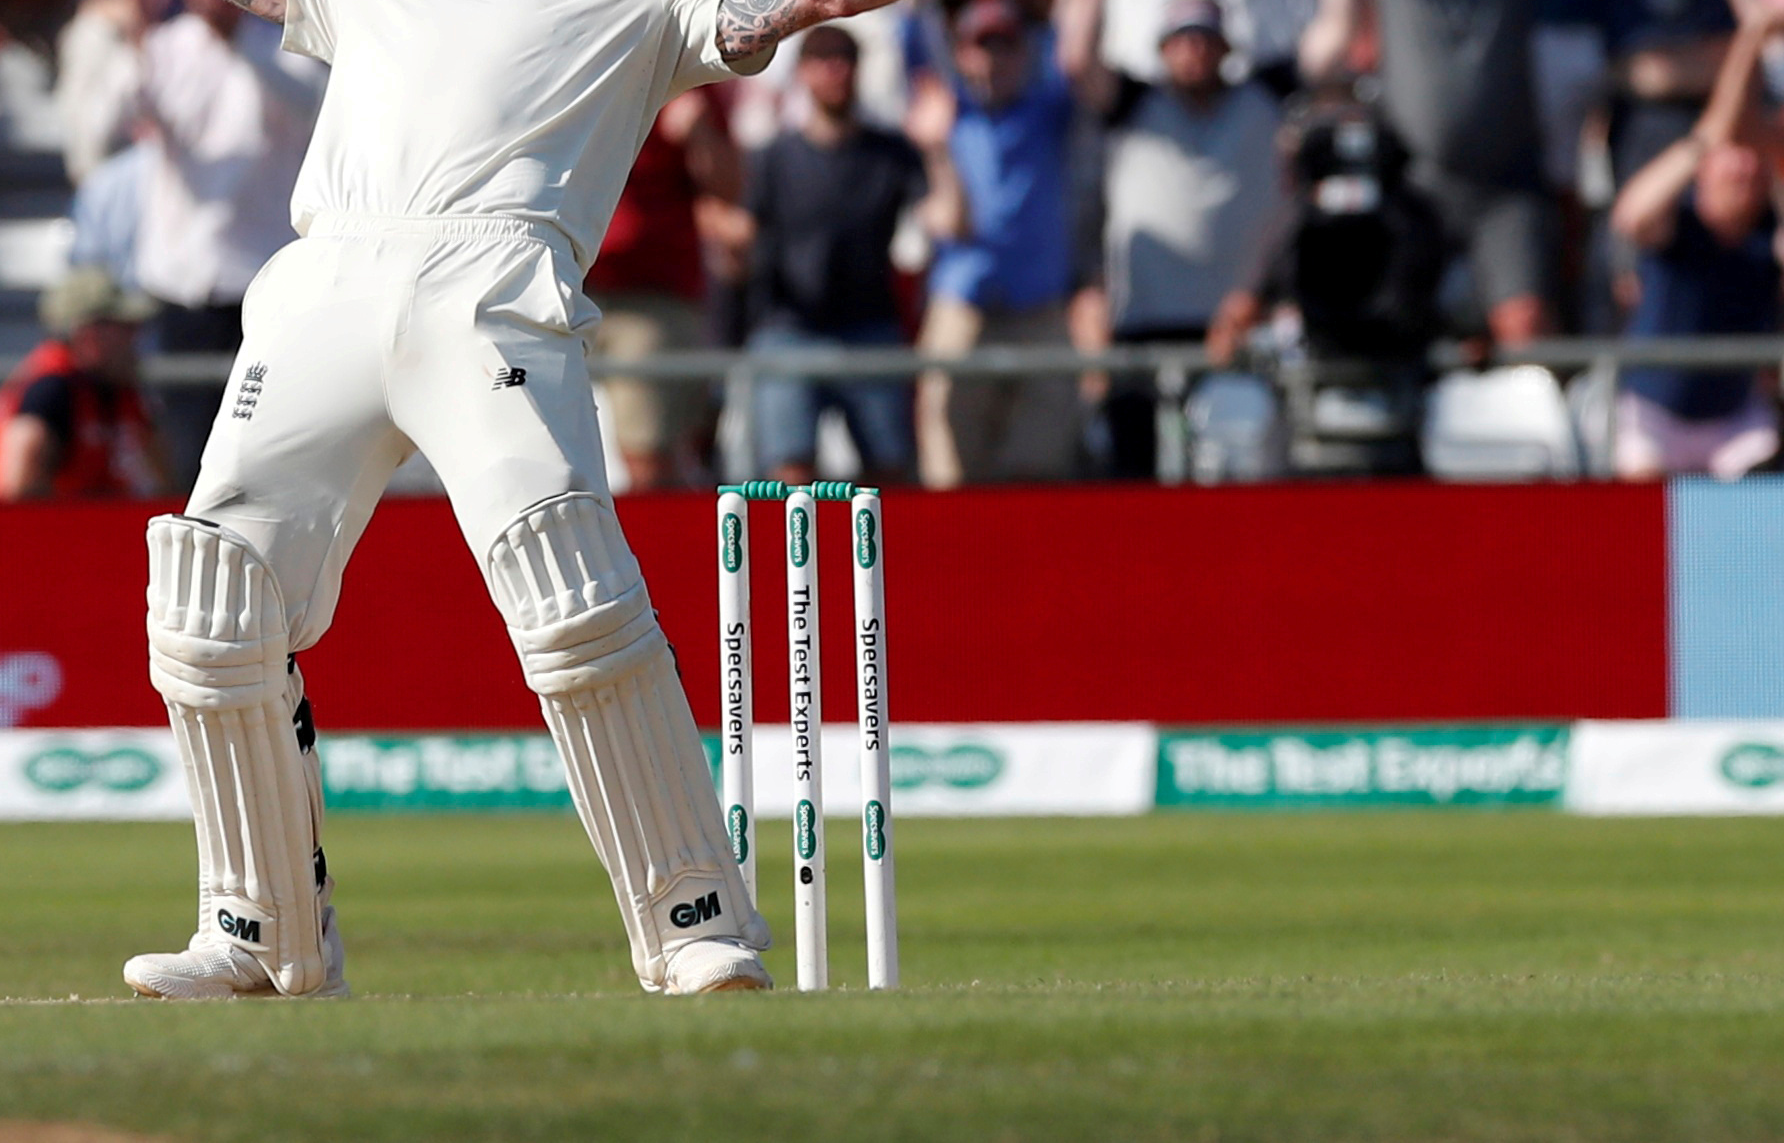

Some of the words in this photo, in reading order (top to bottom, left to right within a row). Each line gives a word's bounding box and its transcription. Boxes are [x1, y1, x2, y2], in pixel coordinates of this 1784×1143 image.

[725, 517, 737, 568] Specsavers
[792, 512, 804, 563] Specsavers
[860, 513, 870, 564] Specsavers
[793, 585, 811, 630] The
[794, 634, 811, 685] Test
[859, 618, 880, 751] Specsavers
[724, 622, 745, 755] Specsavers
[793, 691, 814, 781] Experts
[218, 908, 261, 943] GM
[670, 891, 722, 928] GM
